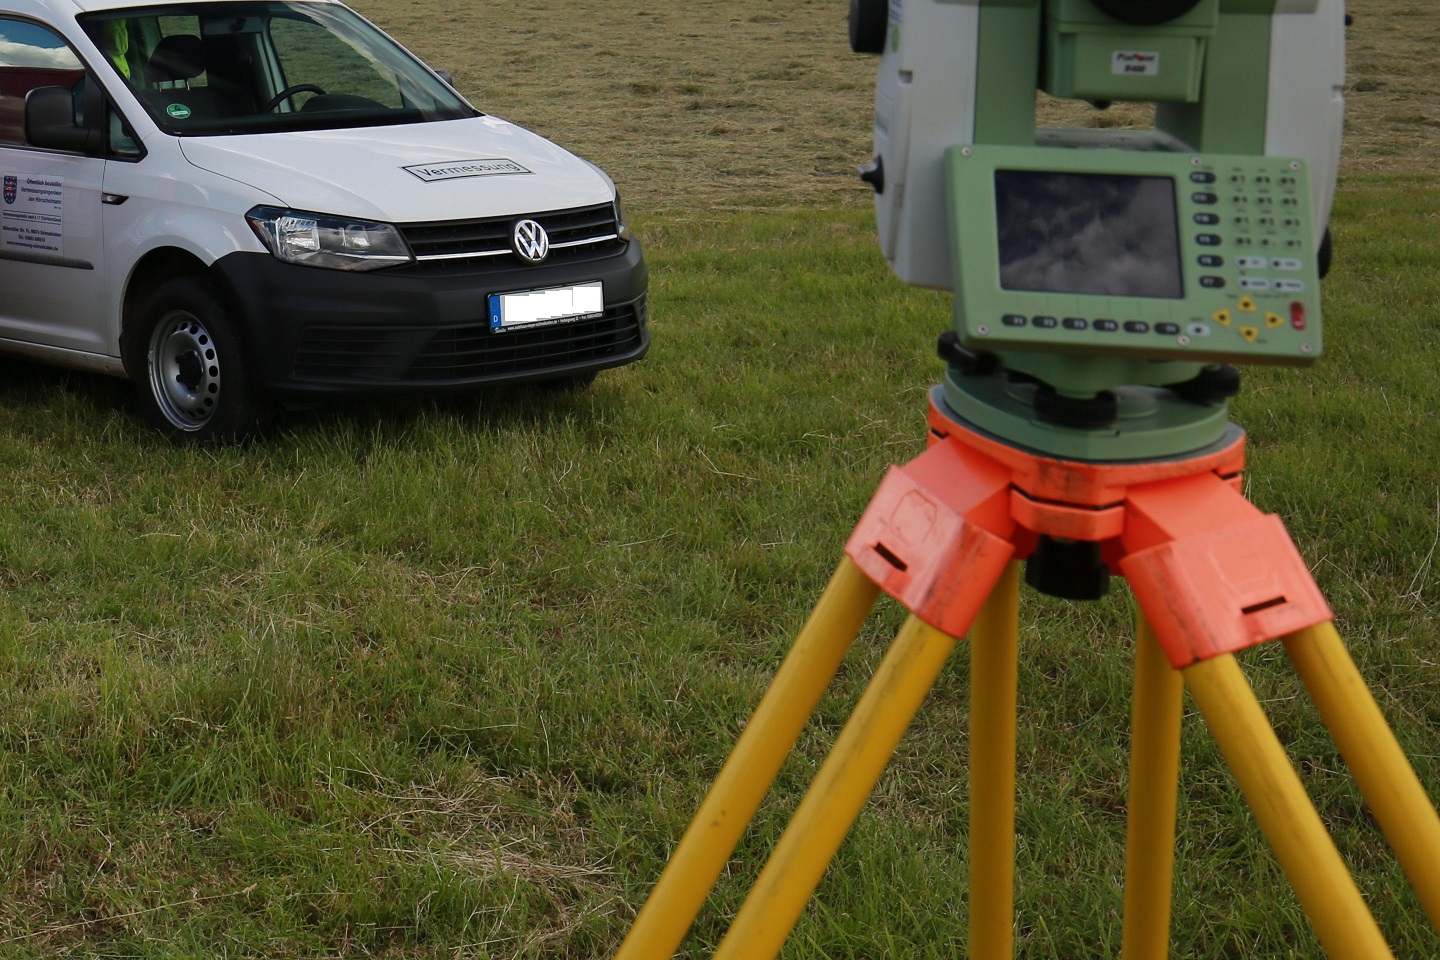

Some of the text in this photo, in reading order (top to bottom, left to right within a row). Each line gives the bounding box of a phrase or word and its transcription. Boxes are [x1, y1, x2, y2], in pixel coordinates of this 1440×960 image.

[416, 163, 521, 177] Vermessung
[21, 186, 62, 196] Vermessungsingenieur
[493, 315, 499, 323] D
